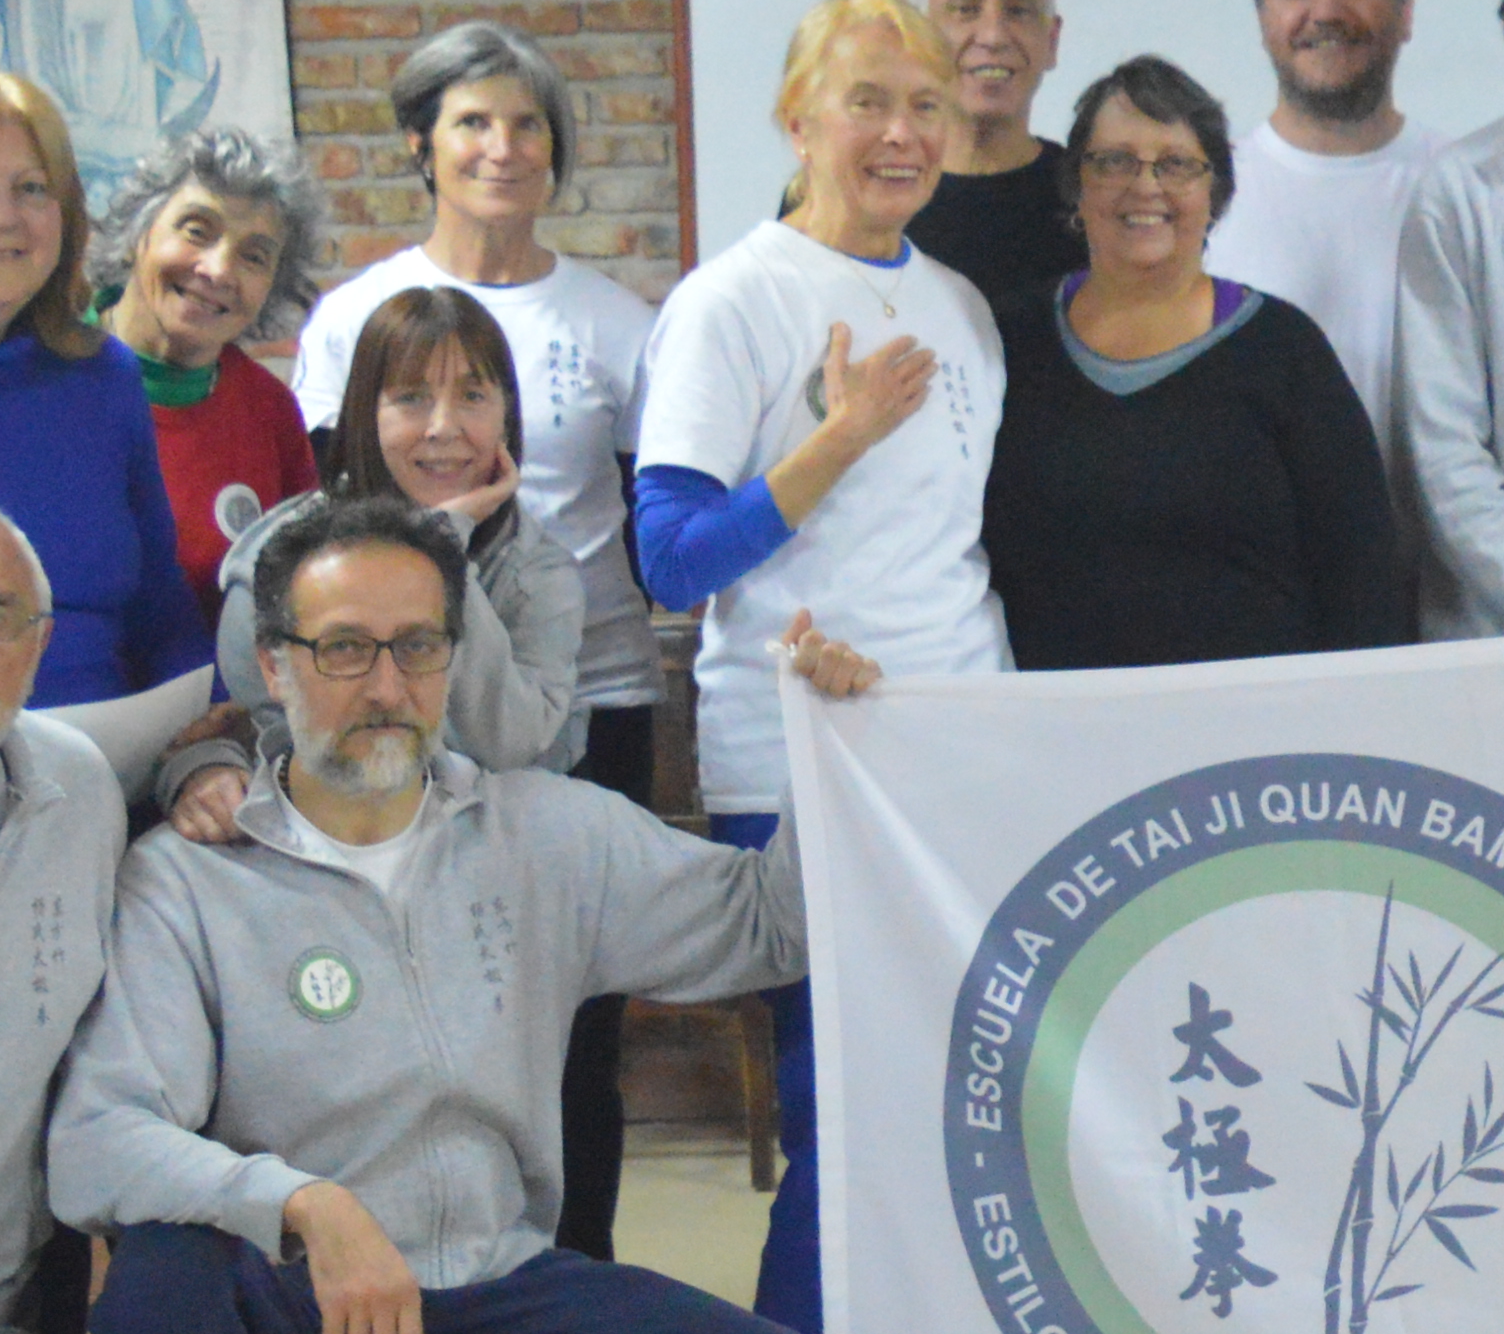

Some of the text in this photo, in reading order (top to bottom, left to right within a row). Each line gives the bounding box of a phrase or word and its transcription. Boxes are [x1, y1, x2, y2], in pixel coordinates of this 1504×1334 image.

[966, 926, 1055, 1133] ESCUELA
[1045, 855, 1117, 918] DE
[1109, 811, 1193, 868] TAI
[1205, 791, 1245, 835] JI
[1259, 781, 1406, 829] QUAN
